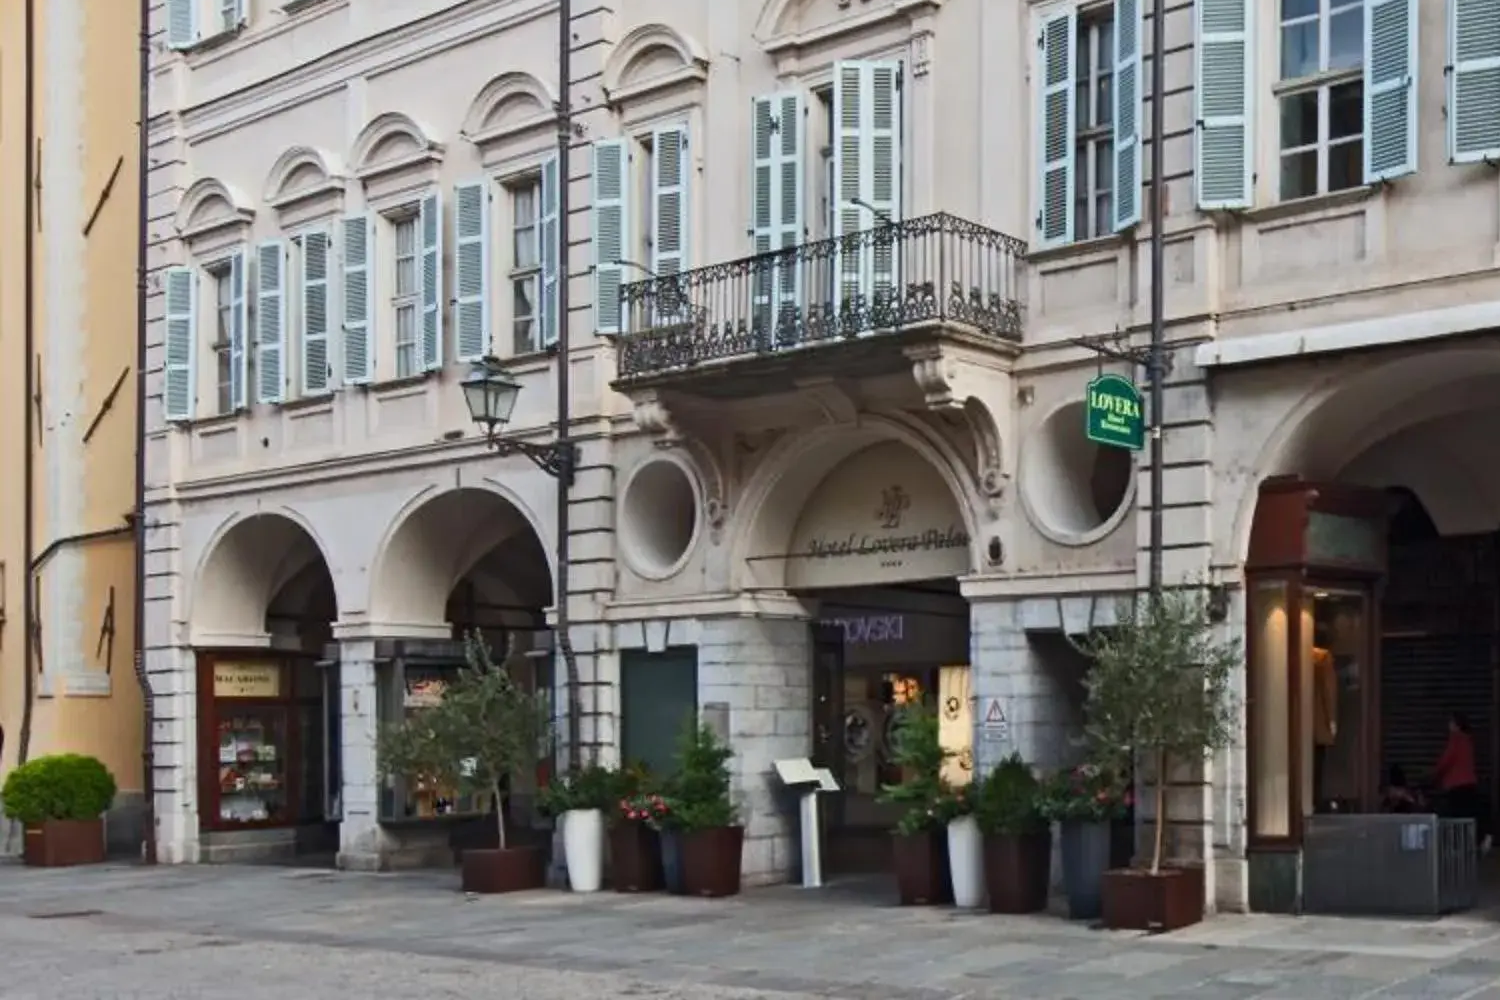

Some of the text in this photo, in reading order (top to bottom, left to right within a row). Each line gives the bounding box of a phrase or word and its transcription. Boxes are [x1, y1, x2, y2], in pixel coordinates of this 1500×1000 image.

[1091, 391, 1140, 418] LOVERA
[919, 523, 971, 551] Palac
[820, 616, 903, 642] OVSKI
